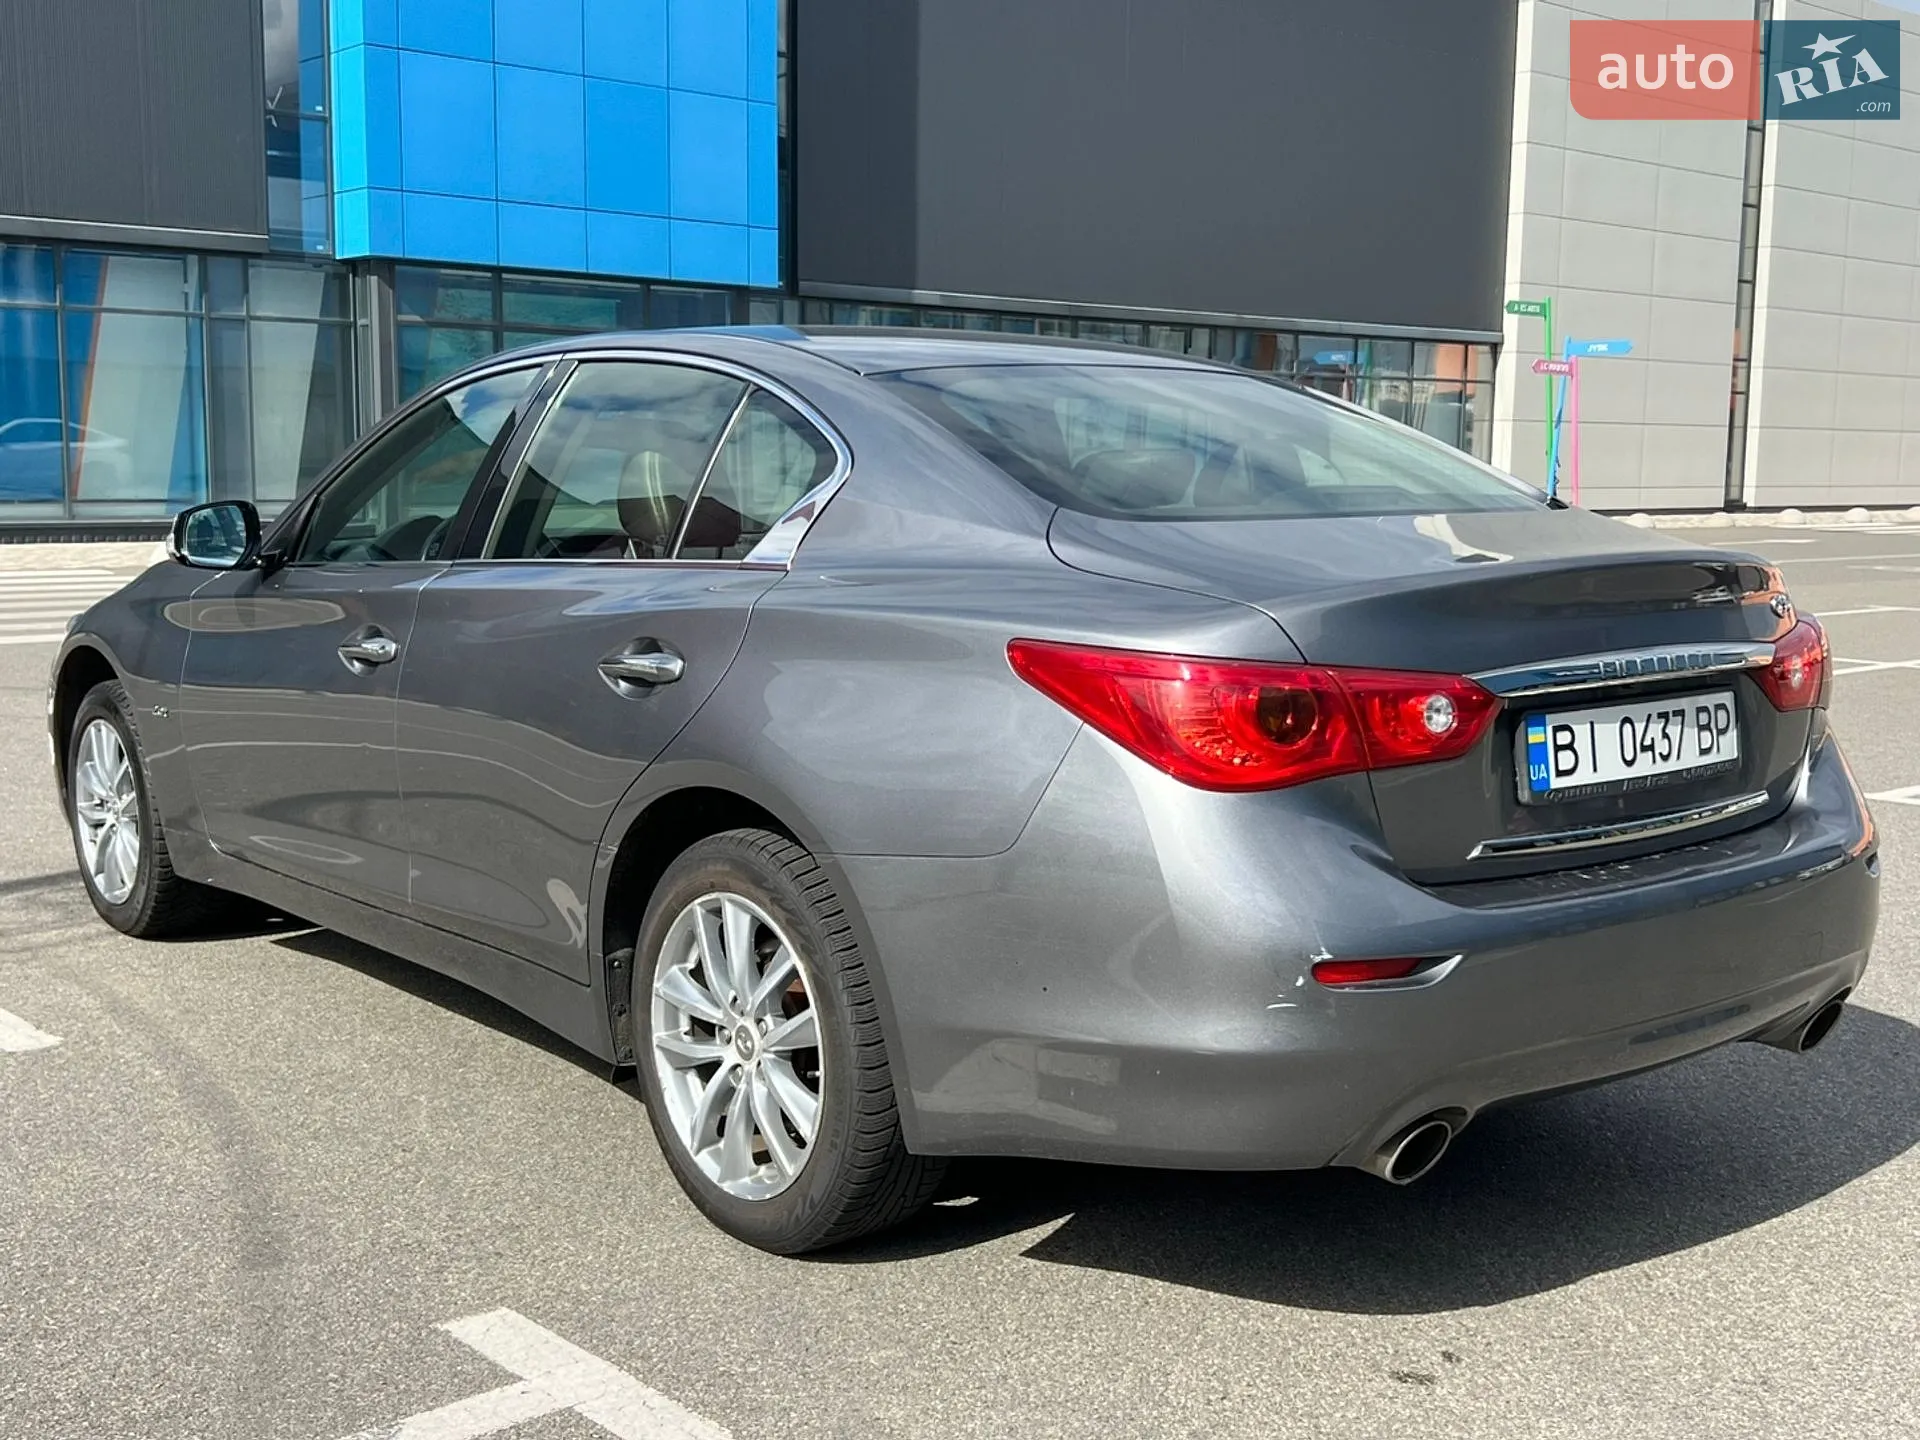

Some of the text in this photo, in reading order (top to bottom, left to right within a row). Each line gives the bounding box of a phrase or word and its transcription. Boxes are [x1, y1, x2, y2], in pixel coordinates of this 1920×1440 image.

[1552, 702, 1731, 778] BI 0437 BP
[1530, 764, 1548, 781] UA
